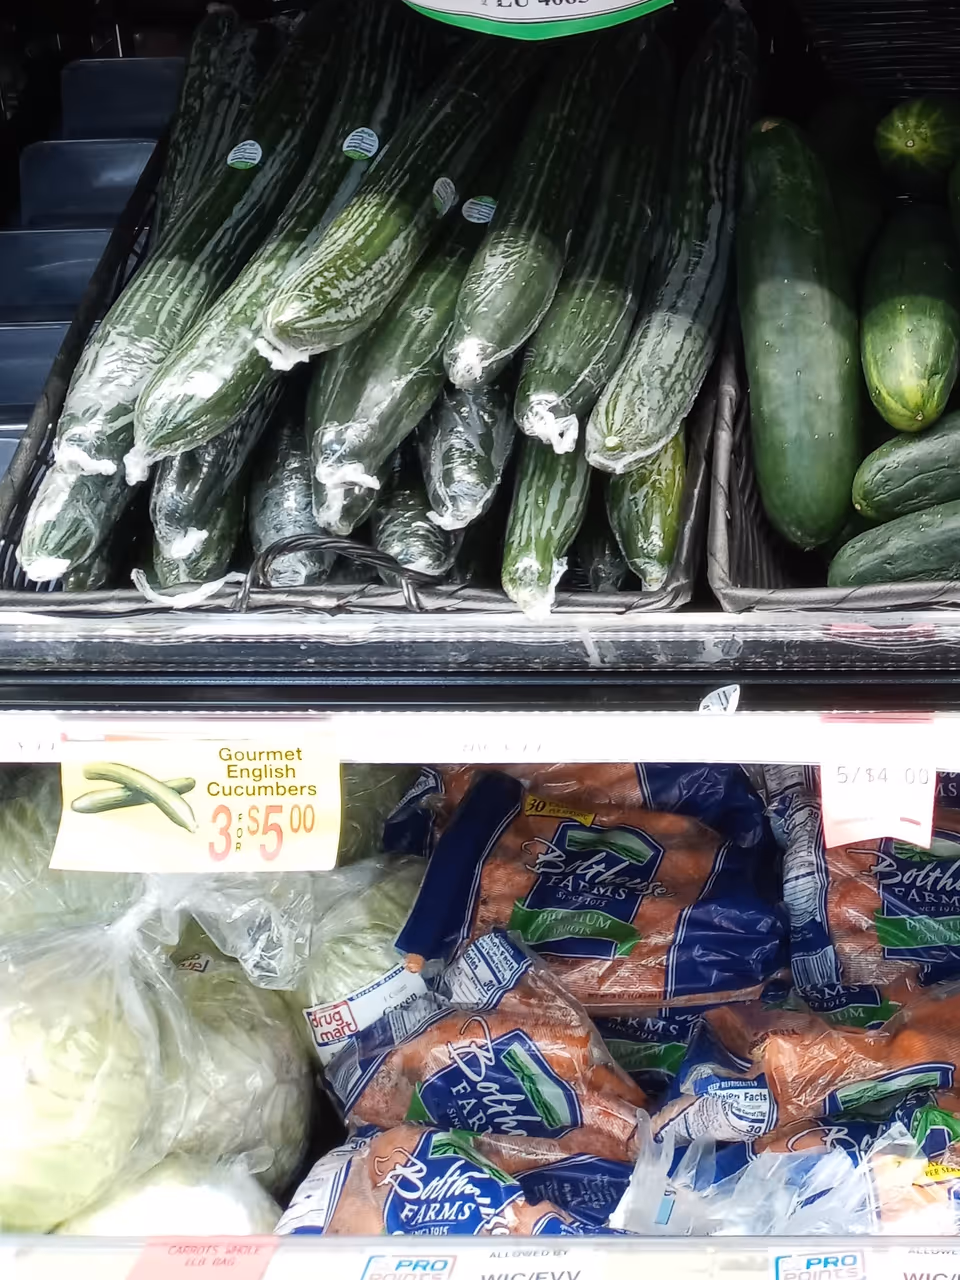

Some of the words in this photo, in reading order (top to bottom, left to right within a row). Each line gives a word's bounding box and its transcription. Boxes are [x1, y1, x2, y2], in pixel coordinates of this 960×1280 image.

[218, 747, 303, 761] Gourmet
[227, 764, 296, 782] English
[837, 766, 929, 785] 5/$400
[207, 781, 317, 796] Cucumbers
[526, 798, 546, 813] 30
[208, 804, 232, 862] 3
[521, 837, 676, 898] Bolthouse
[311, 1011, 343, 1030] drug
[319, 1020, 352, 1044] mart
[743, 1091, 767, 1101] Facts
[746, 1125, 762, 1134] 30
[925, 1168, 940, 1177] PER
[401, 1201, 476, 1225] FARMS
[488, 1249, 550, 1259] ALLOWED
[806, 1254, 858, 1268] PRO
[395, 1259, 448, 1271] PRO
